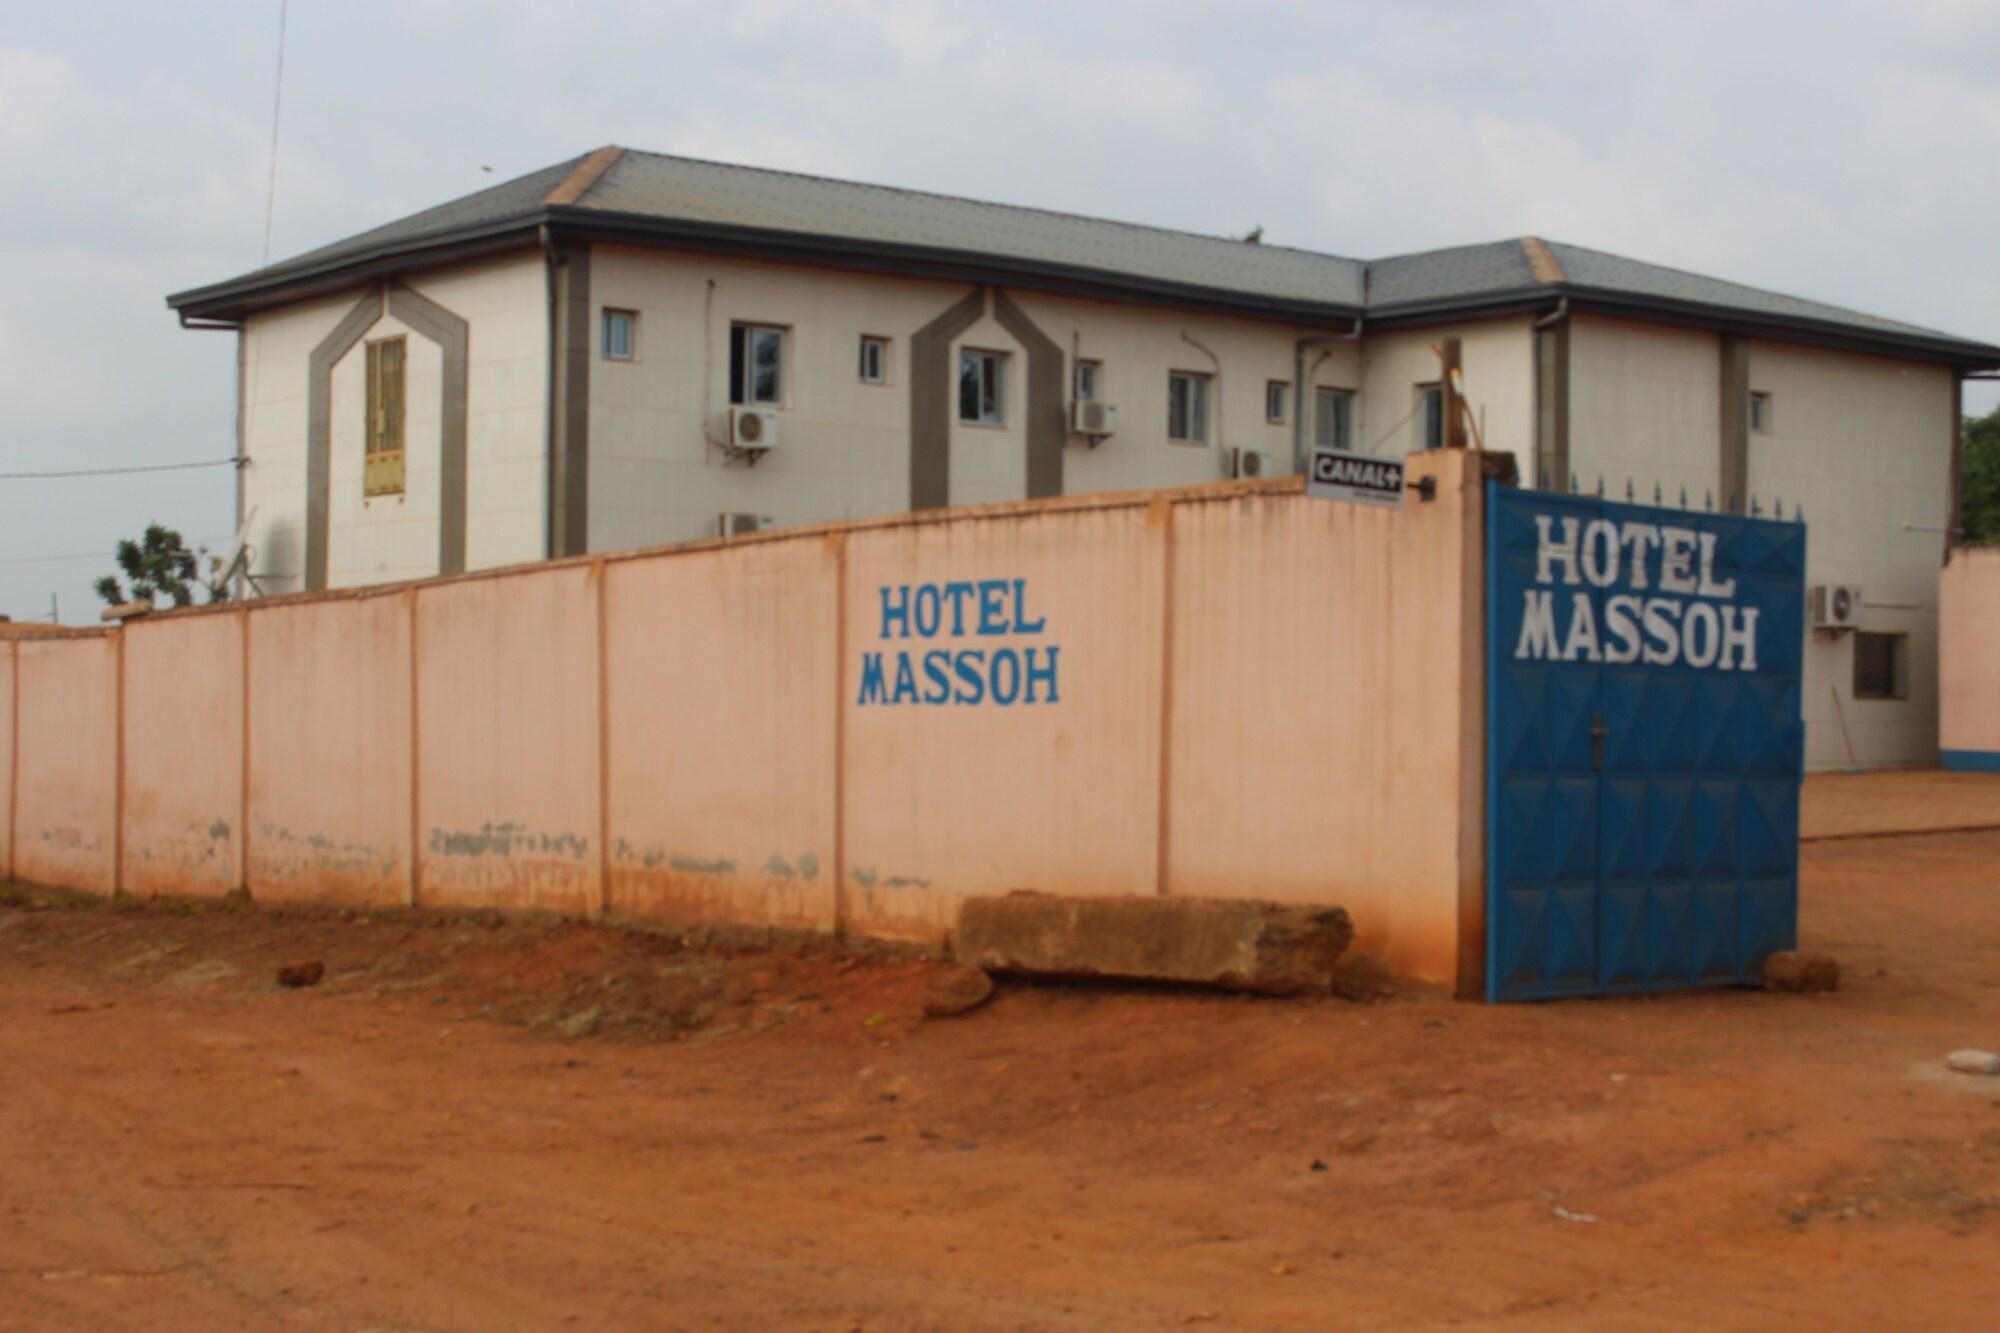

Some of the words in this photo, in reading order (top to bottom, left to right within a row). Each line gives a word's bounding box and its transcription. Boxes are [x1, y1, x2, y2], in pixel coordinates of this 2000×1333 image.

[1316, 456, 1400, 489] CANAL+
[1535, 514, 1737, 598] HOTEL
[879, 578, 1046, 639] HOTEL
[1514, 589, 1760, 671] MASSOH
[857, 645, 1060, 706] MASSOH
